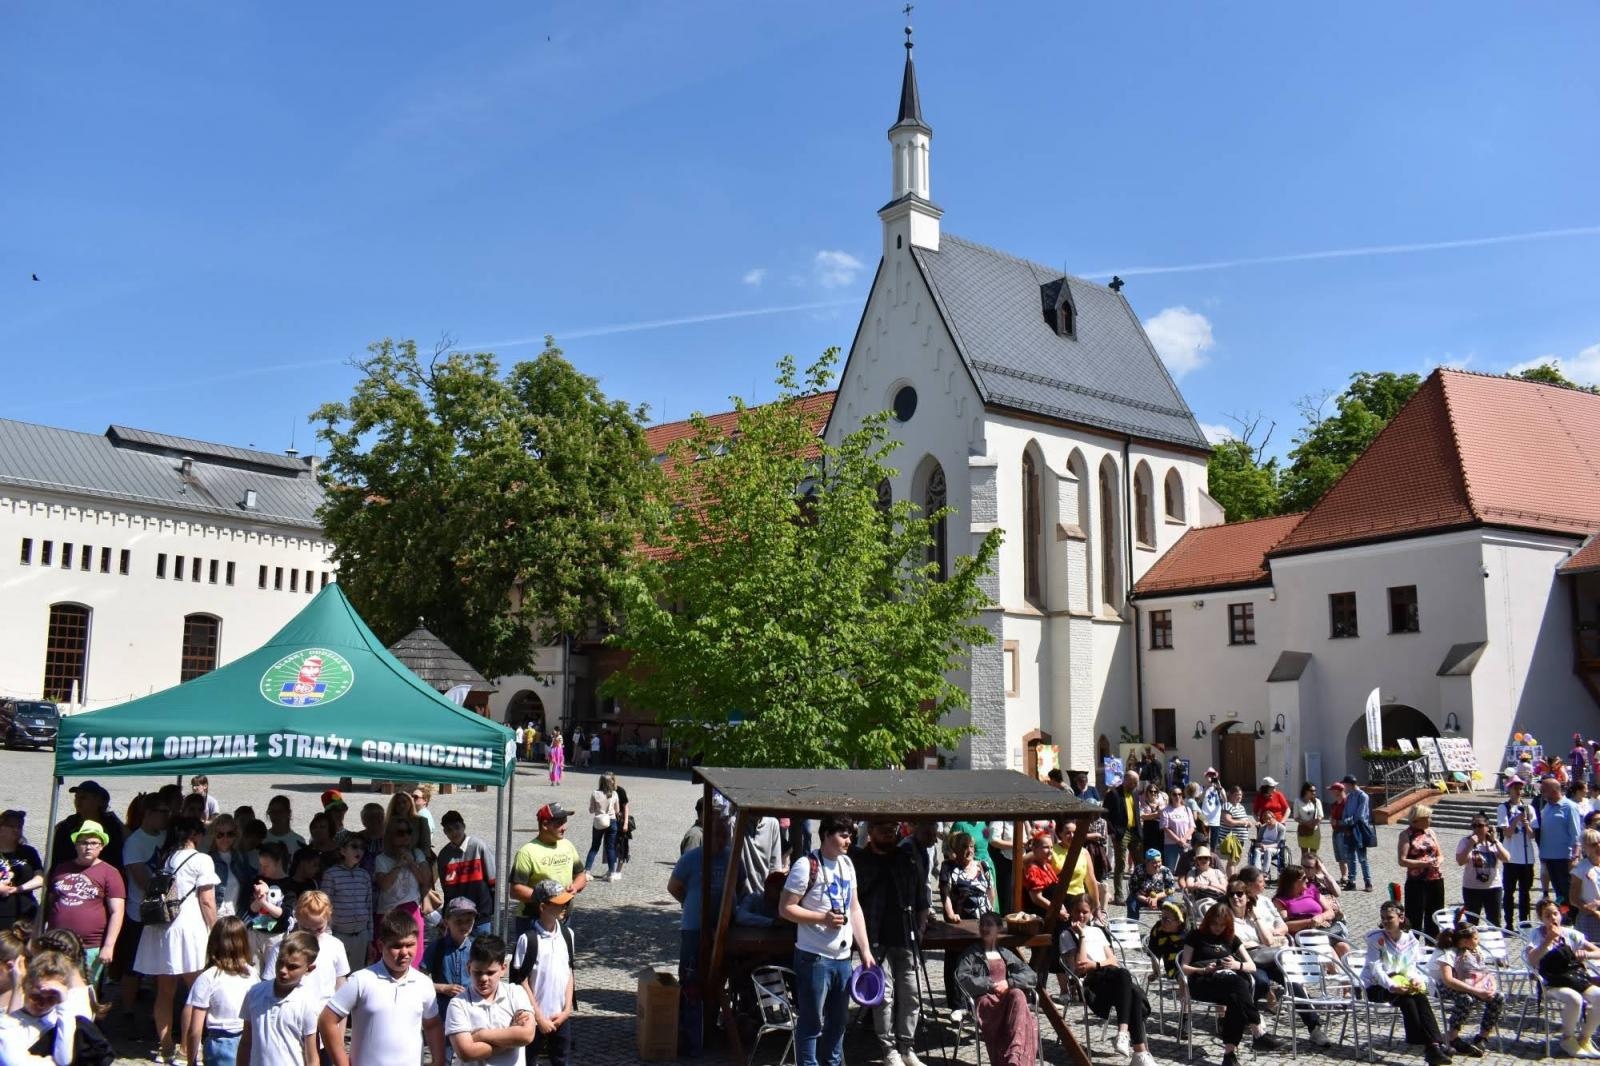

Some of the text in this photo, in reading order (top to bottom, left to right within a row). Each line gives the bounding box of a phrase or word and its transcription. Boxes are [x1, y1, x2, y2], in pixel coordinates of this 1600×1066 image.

[72, 732, 154, 764] ŚLĄSKI
[163, 734, 259, 760] ODDZIAŁ
[268, 733, 352, 761] STRAŻY
[361, 740, 493, 769] GRANICZNEJ
